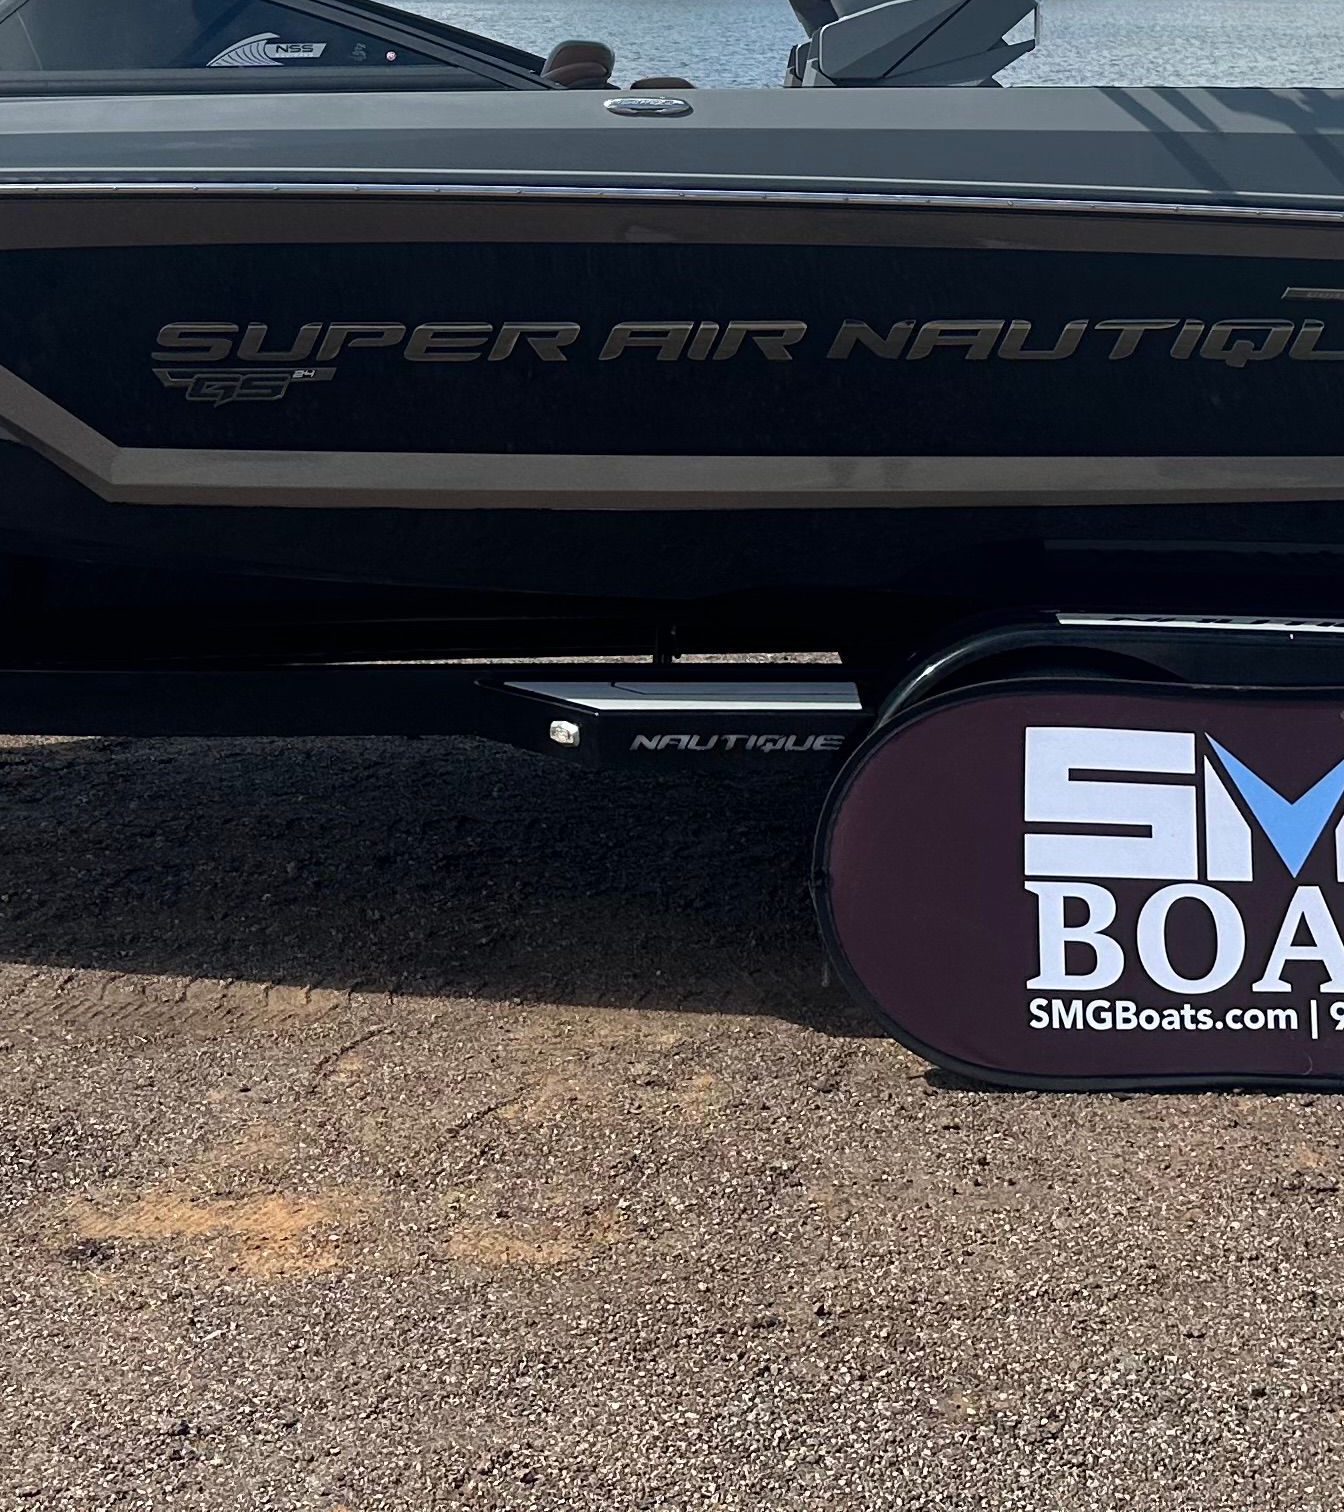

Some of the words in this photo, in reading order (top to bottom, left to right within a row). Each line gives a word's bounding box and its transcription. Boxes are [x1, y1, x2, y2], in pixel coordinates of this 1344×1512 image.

[275, 44, 314, 54] NSS
[151, 321, 581, 362] SUPER
[598, 320, 808, 361] AIR
[629, 734, 846, 752] NAUTIQUE
[1028, 998, 1299, 1034] SMGBoats.com
